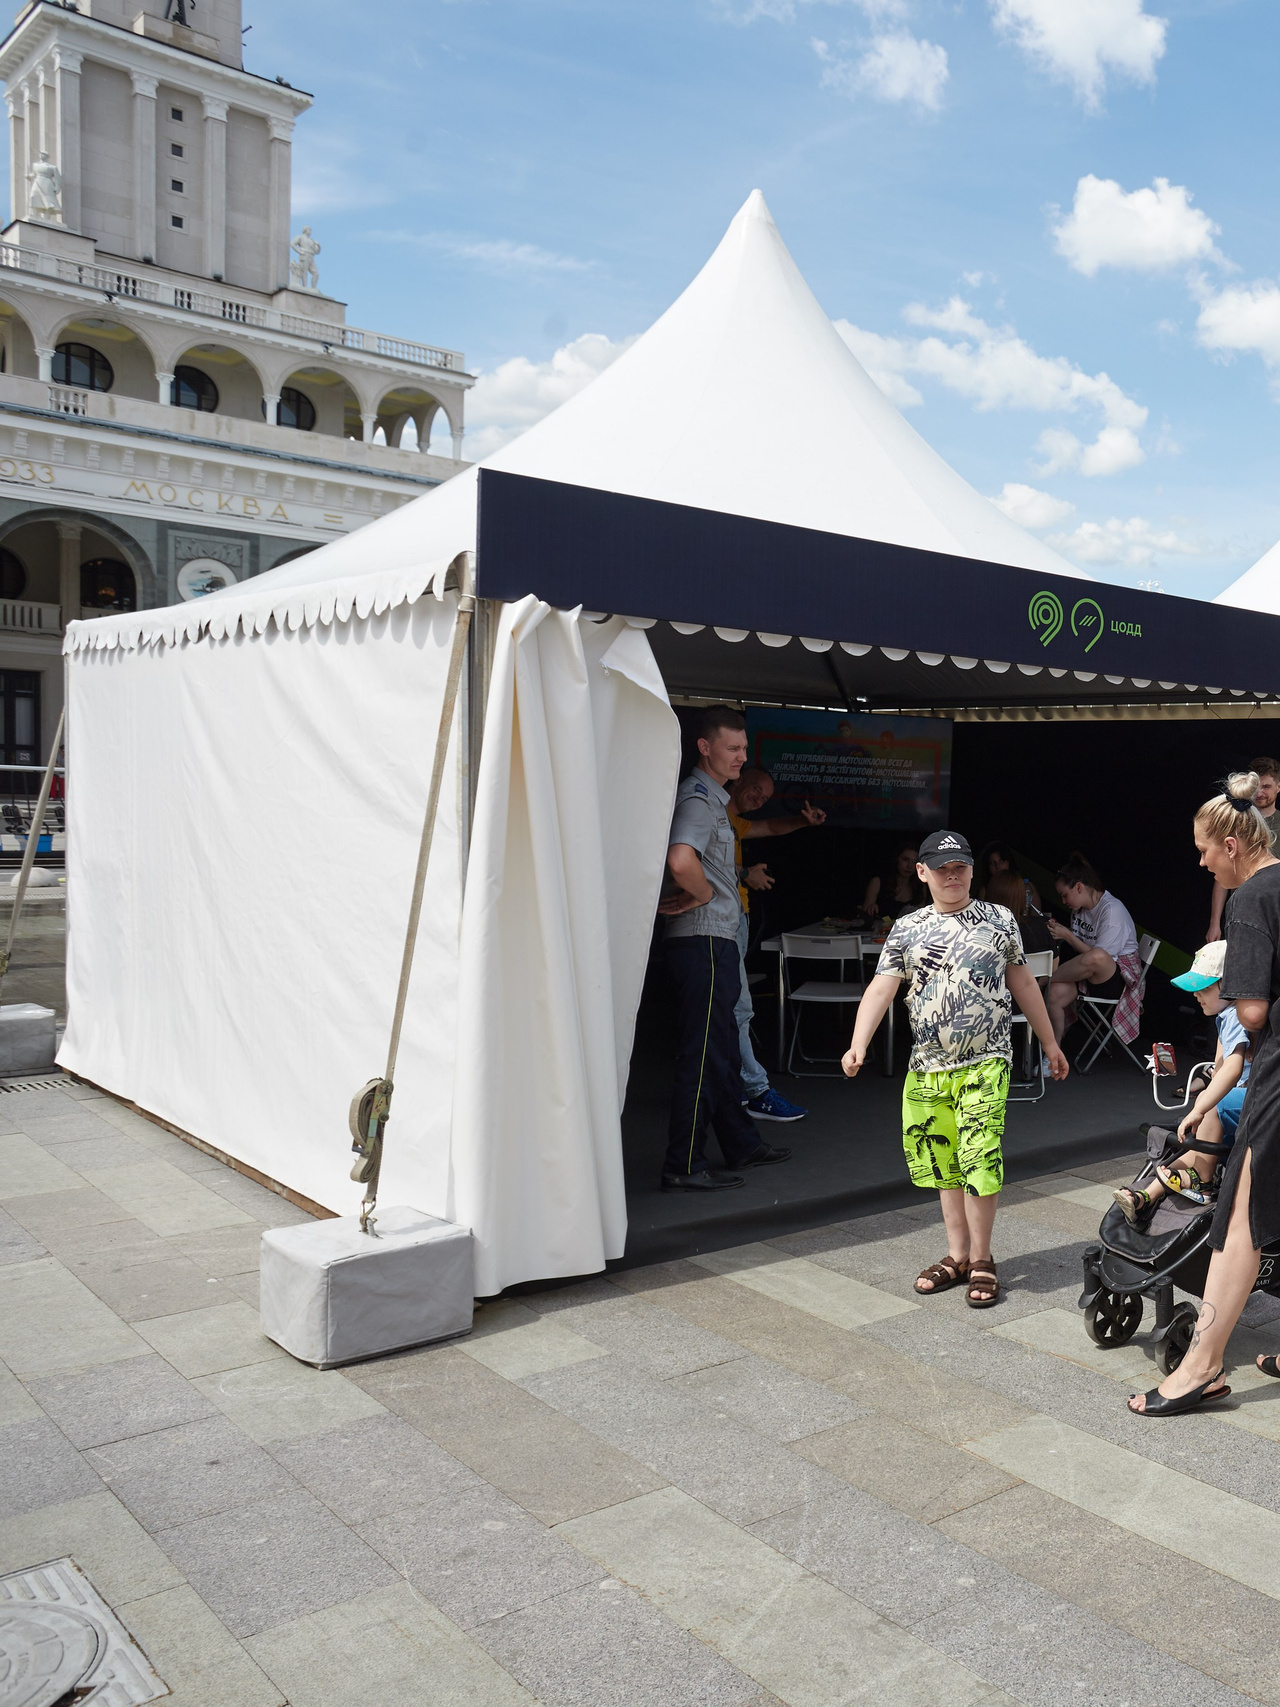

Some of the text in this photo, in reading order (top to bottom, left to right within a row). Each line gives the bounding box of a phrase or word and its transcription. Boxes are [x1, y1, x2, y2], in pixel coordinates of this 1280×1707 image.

[123, 480, 289, 521] МОСКВА
[1110, 620, 1142, 638] ЦОДД
[781, 752, 795, 761] ПРИ
[796, 753, 838, 763] УПРАВЛЕНИИ
[888, 759, 913, 768] ВСЕГДА
[773, 762, 799, 771] НУЖНО
[799, 764, 819, 773] БЫТЬ
[819, 765, 826, 773] В
[779, 773, 821, 783] ПЕРЕВОЗИТЬ
[822, 775, 867, 786] ПАССАЖИРОВ
[867, 777, 881, 786] БЕЗ
[937, 842, 962, 850] adidas
